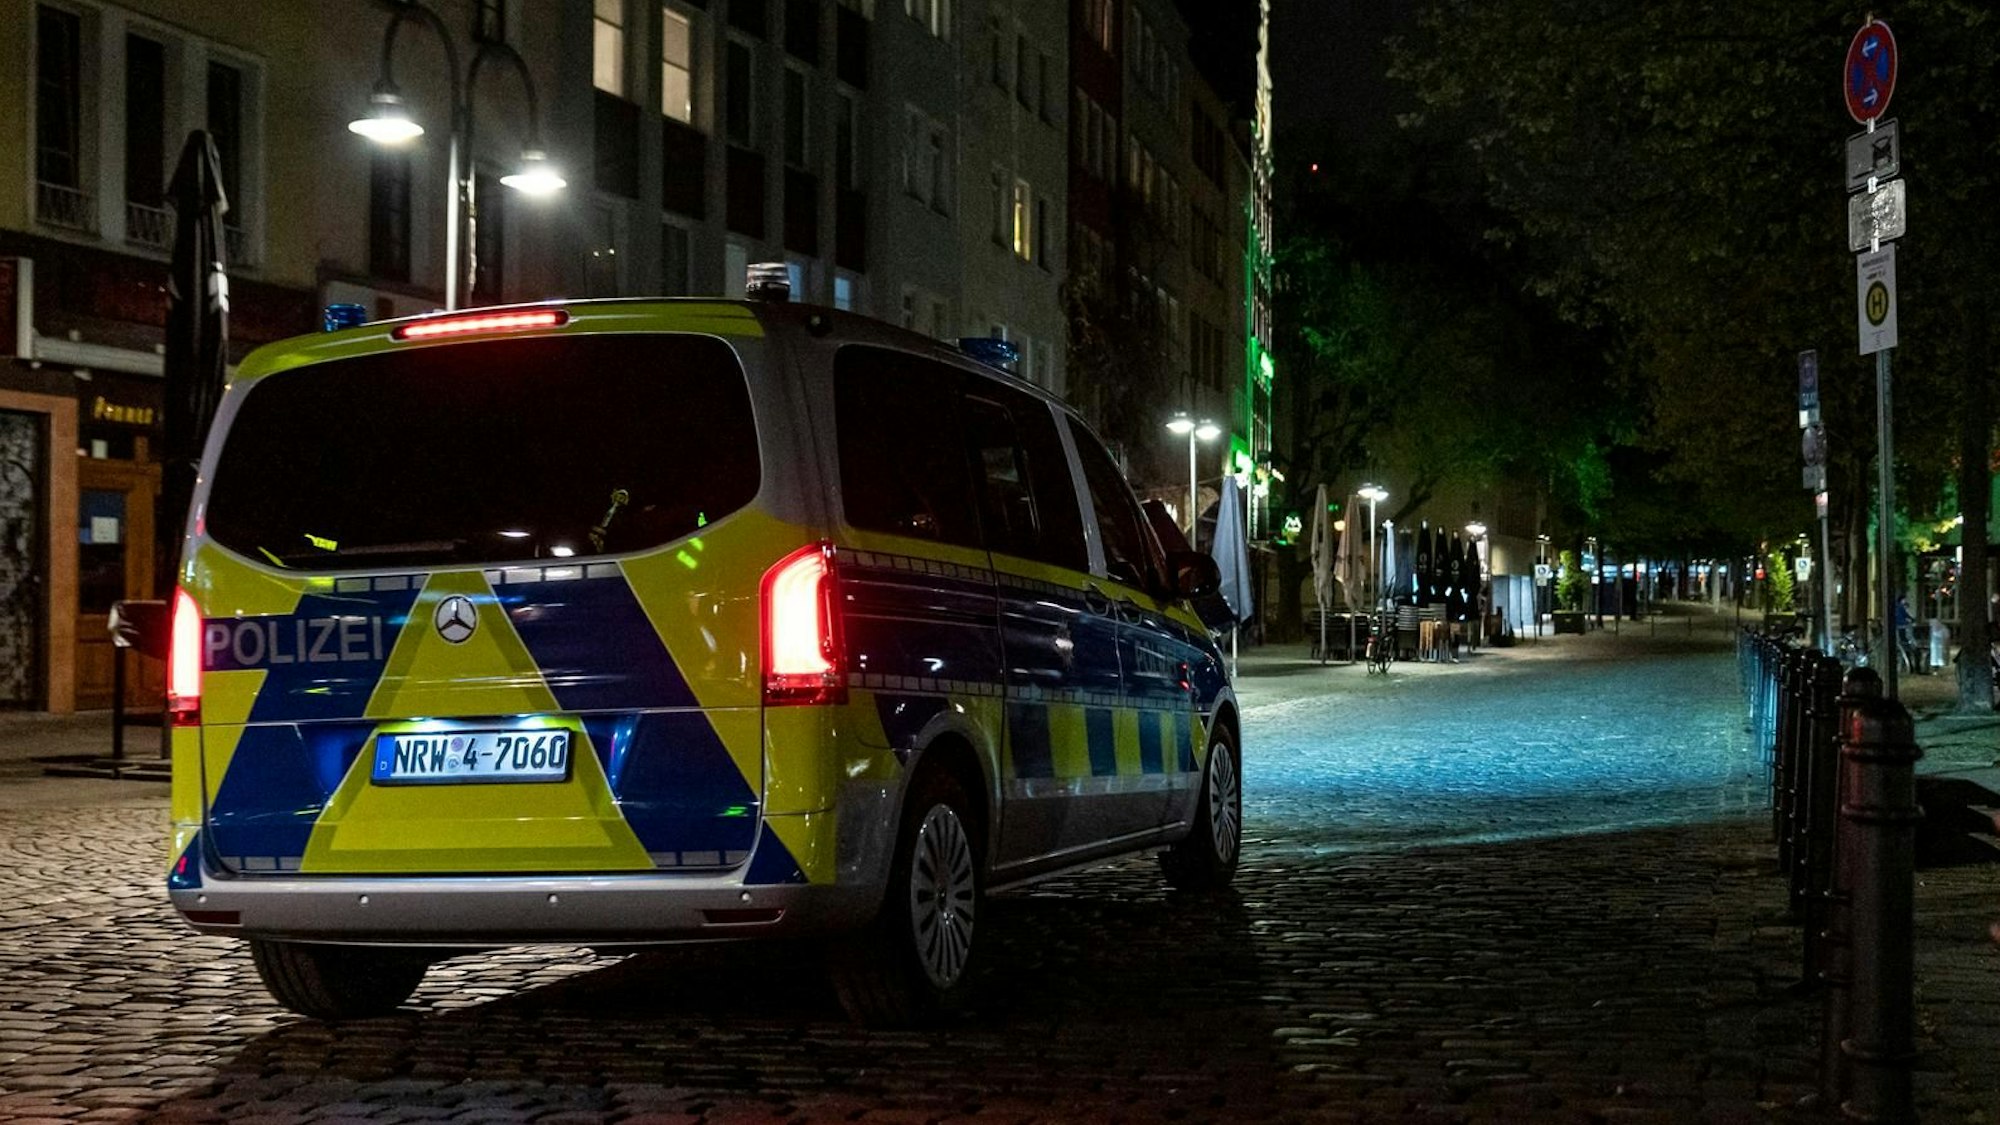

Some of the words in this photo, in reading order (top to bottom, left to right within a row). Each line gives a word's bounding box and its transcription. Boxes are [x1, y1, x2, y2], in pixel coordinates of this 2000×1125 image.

[1872, 292, 1882, 315] H
[205, 615, 384, 667] POLIZEI
[379, 761, 388, 771] D
[393, 739, 447, 773] NRW
[463, 735, 566, 771] 4-7060
